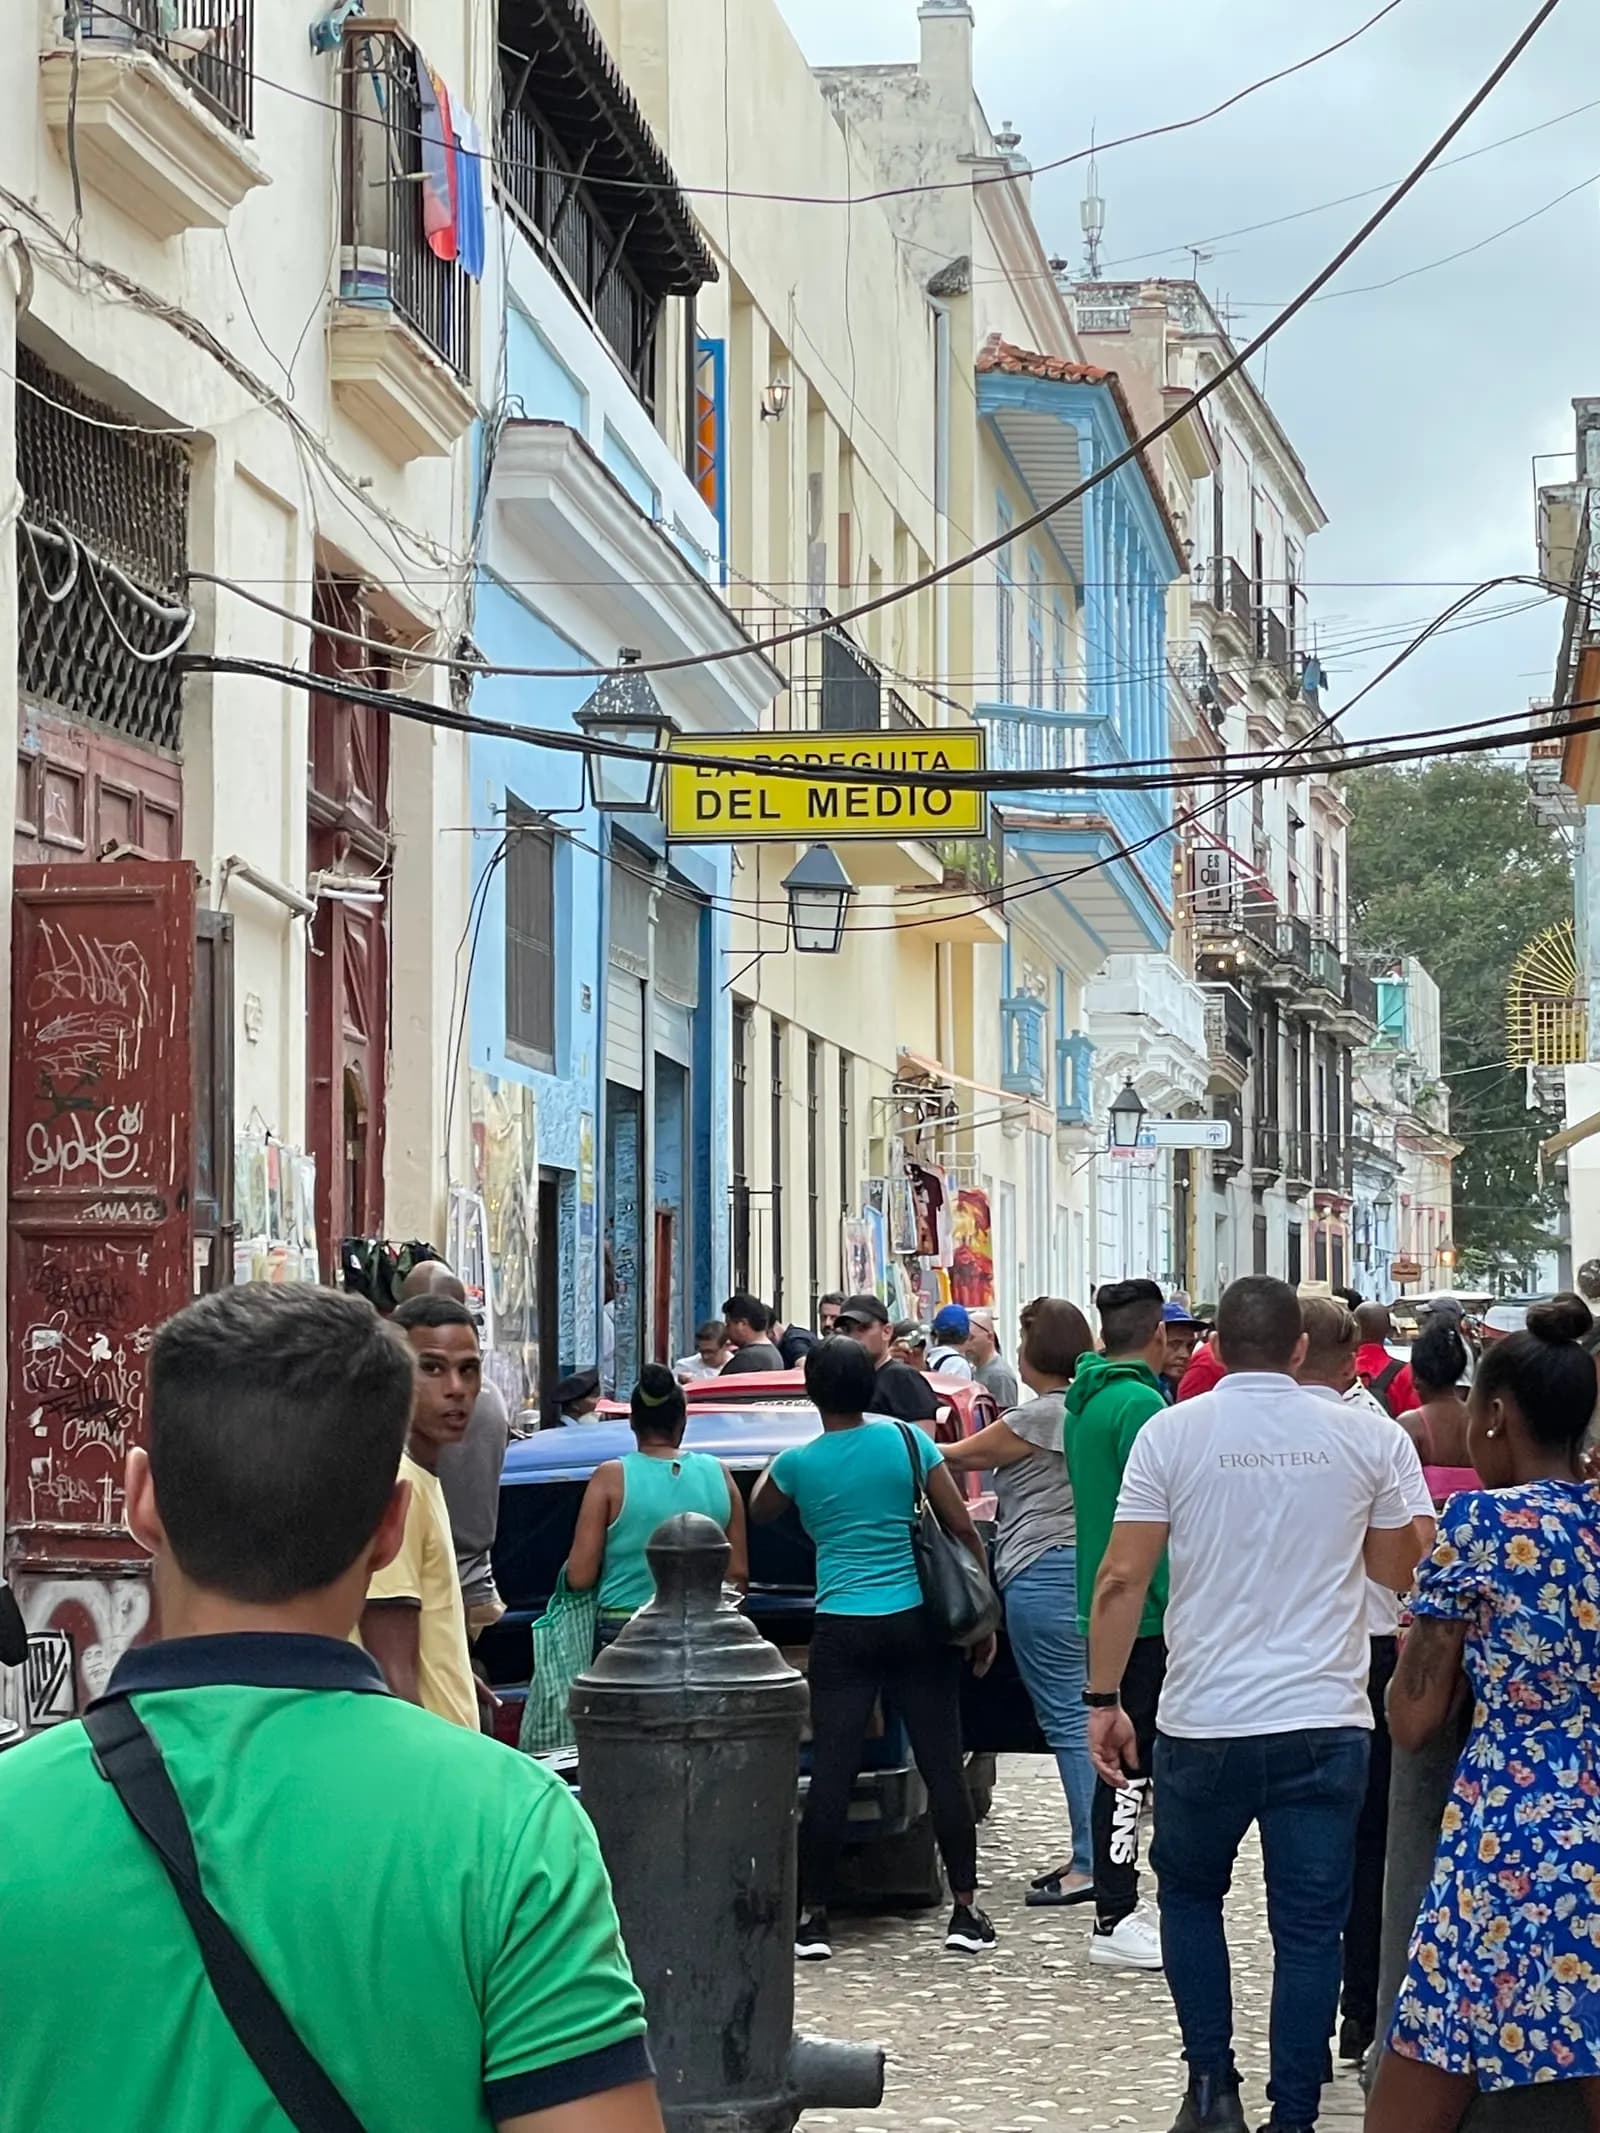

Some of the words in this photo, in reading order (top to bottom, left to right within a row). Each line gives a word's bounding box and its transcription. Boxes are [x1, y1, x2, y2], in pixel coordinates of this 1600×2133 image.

[696, 789, 781, 820] DEL
[808, 786, 952, 818] MEDIO
[1218, 1451, 1330, 1468] FRONTERA
[1110, 1778, 1146, 1864] VANS
